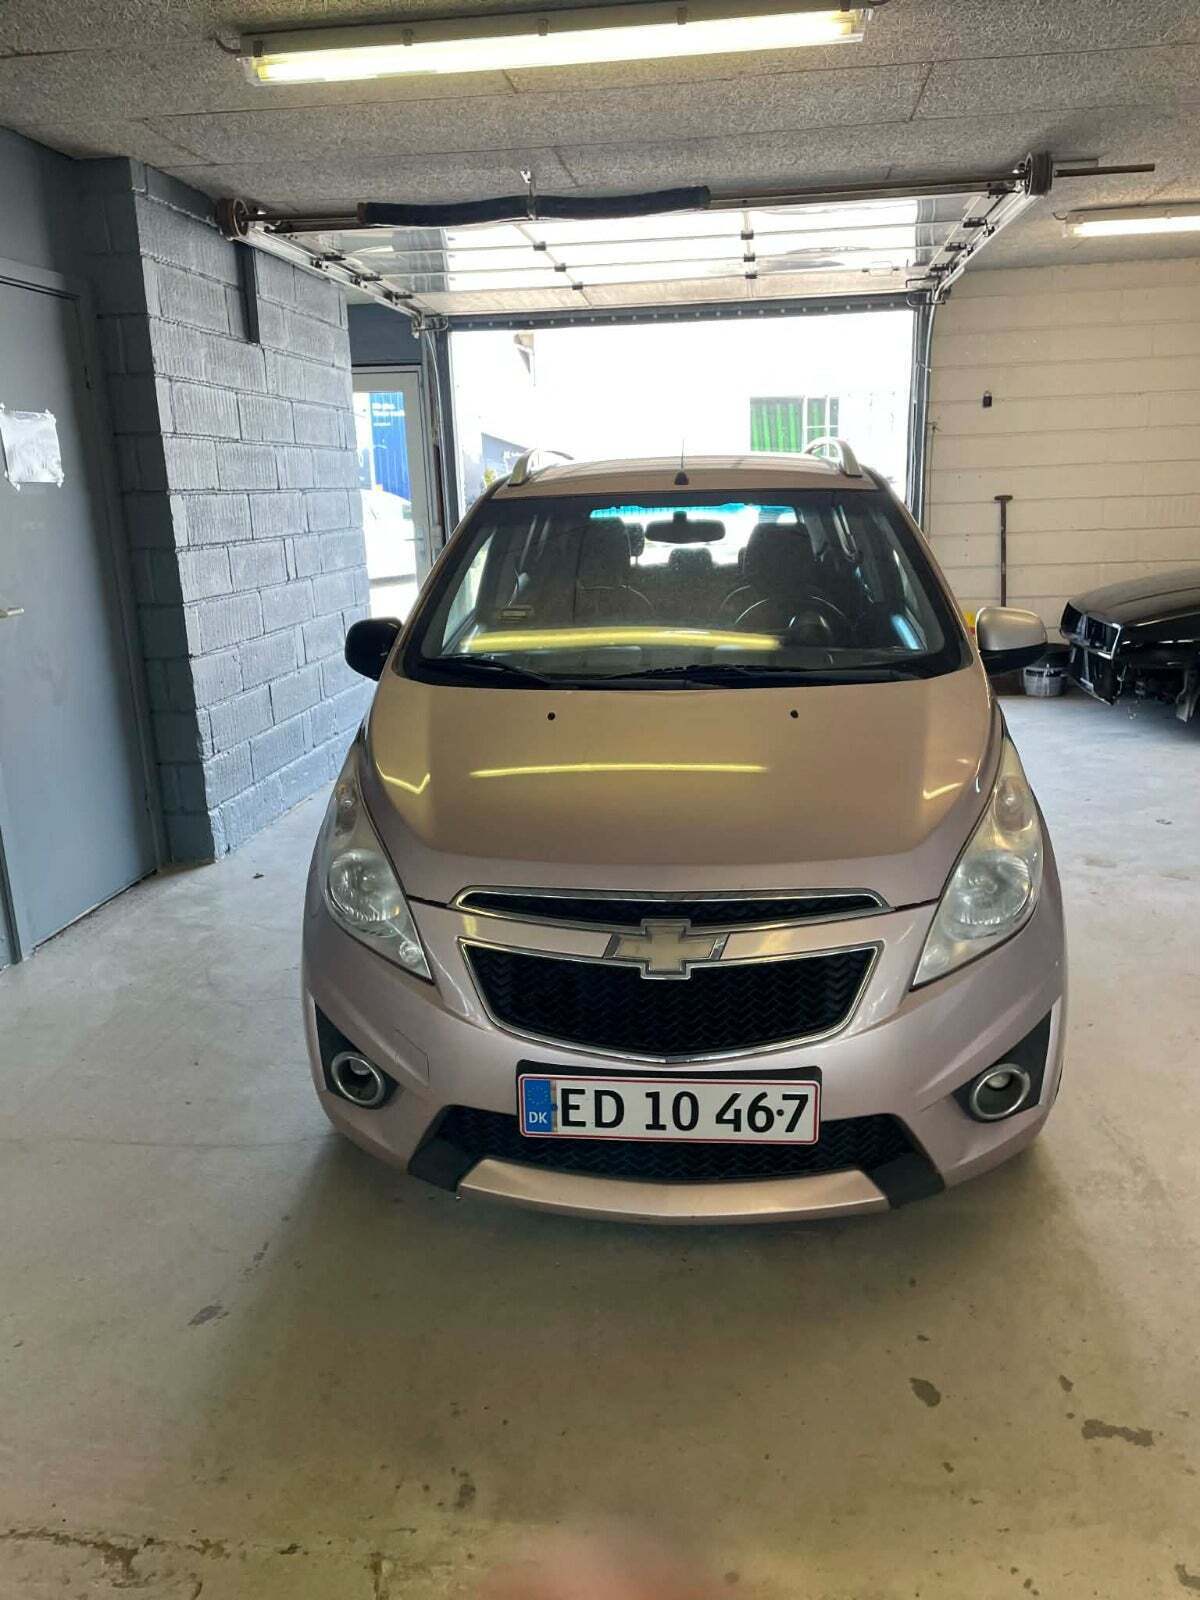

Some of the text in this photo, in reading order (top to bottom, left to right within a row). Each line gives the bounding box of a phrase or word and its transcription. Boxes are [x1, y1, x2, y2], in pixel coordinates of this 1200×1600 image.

[528, 1111, 548, 1124] DK
[561, 1088, 625, 1129] ED
[645, 1091, 699, 1132] 10
